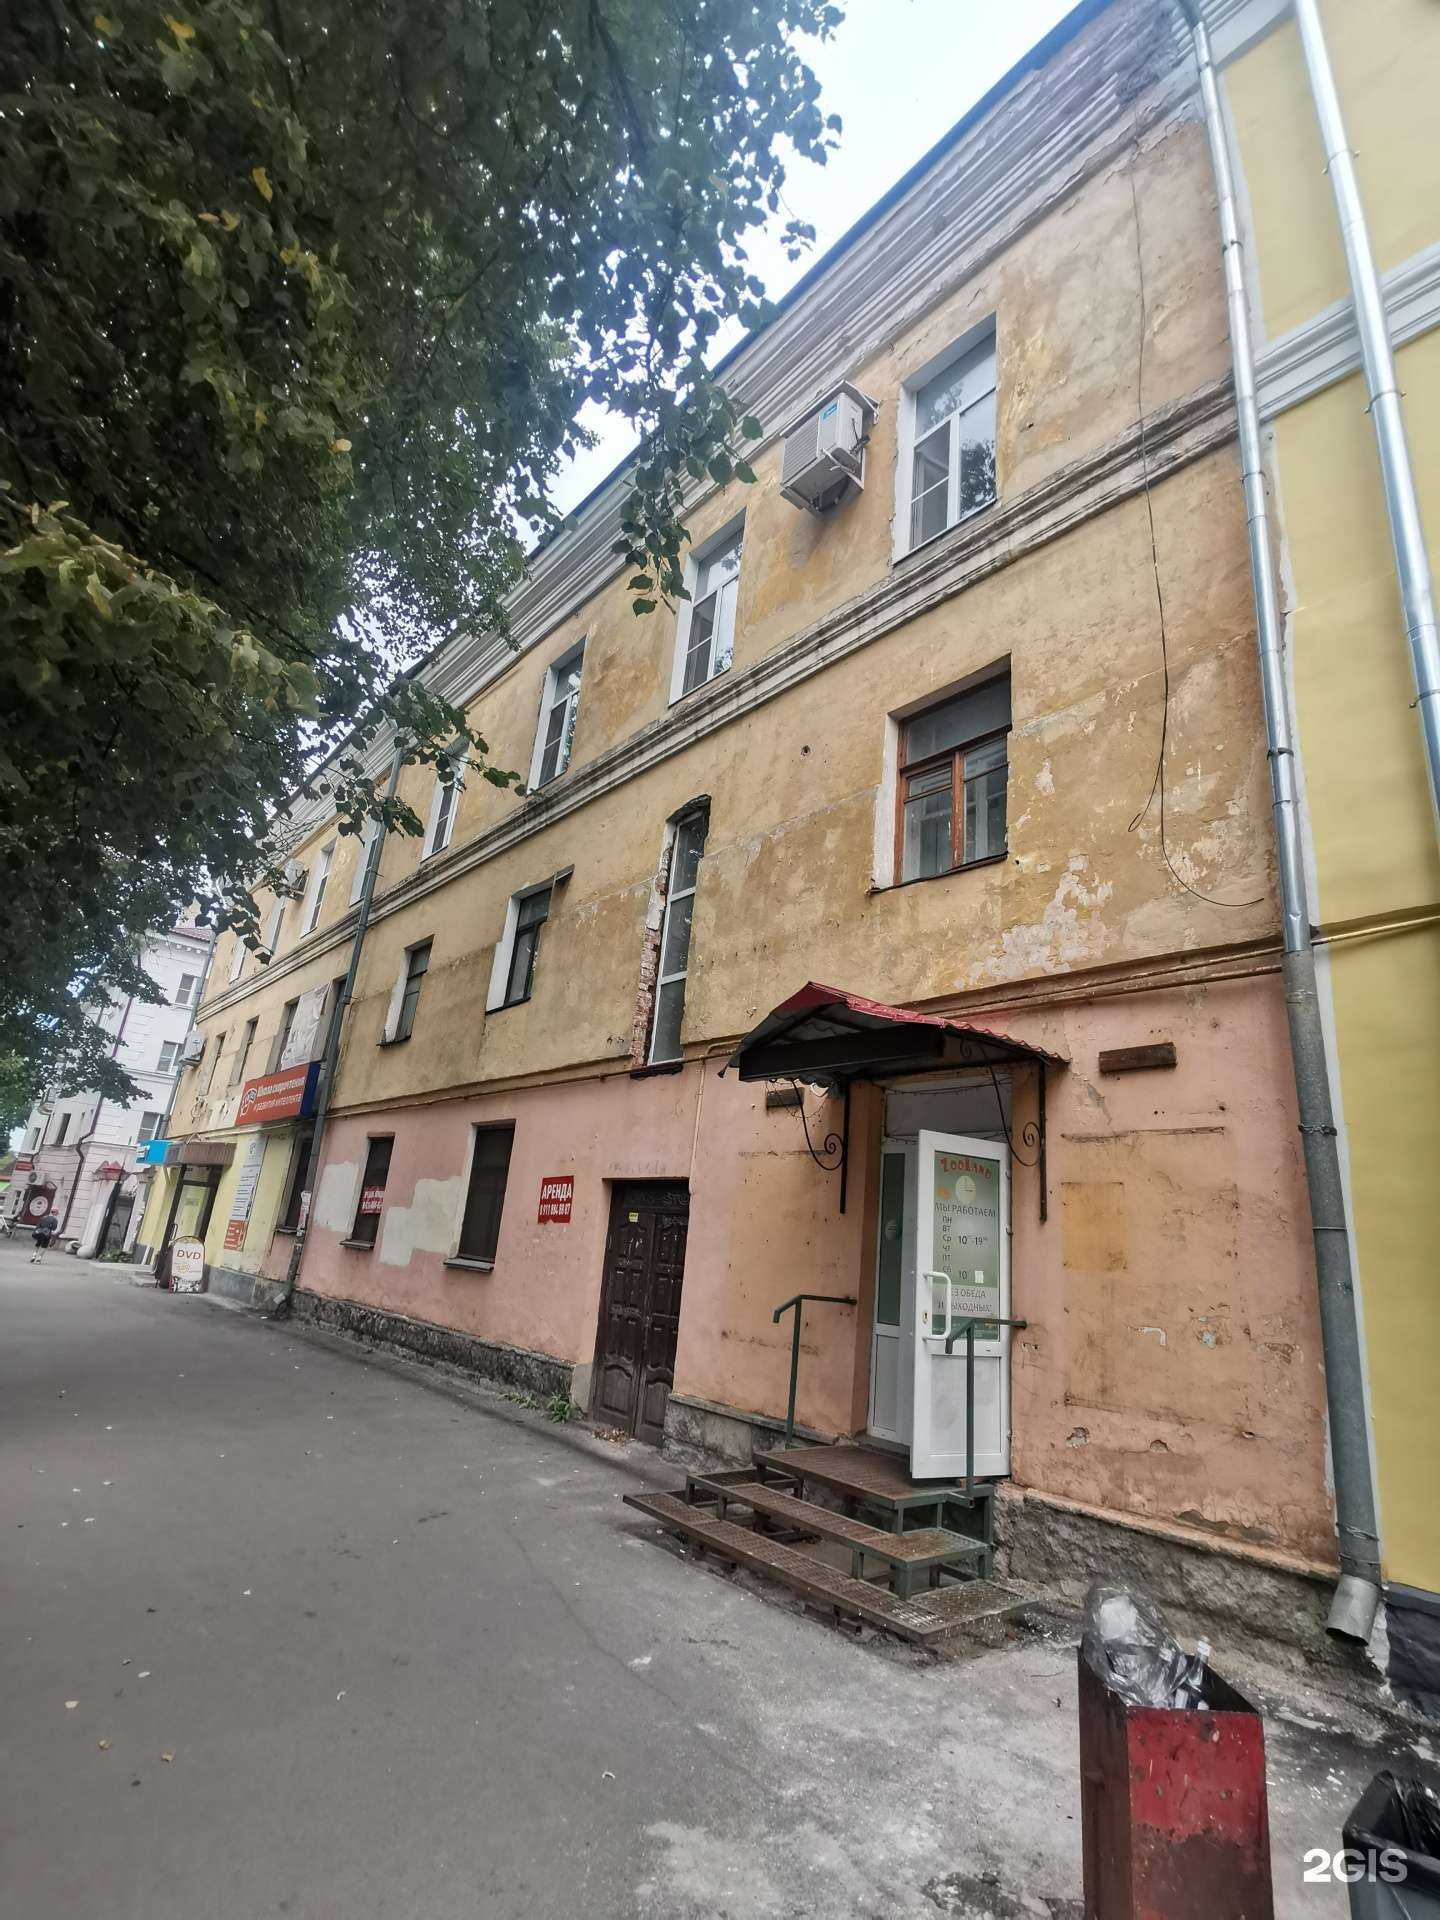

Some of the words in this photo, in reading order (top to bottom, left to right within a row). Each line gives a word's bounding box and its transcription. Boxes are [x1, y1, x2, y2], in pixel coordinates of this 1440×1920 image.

[541, 1184, 572, 1201] АРЕНДА
[935, 1202, 951, 1212] МЫ
[952, 1204, 996, 1217] РАБОТАЕМ
[177, 1249, 201, 1260] DVD
[961, 1288, 985, 1299] ОБЕДА
[951, 1301, 992, 1313] ЫХОДНЫХ!
